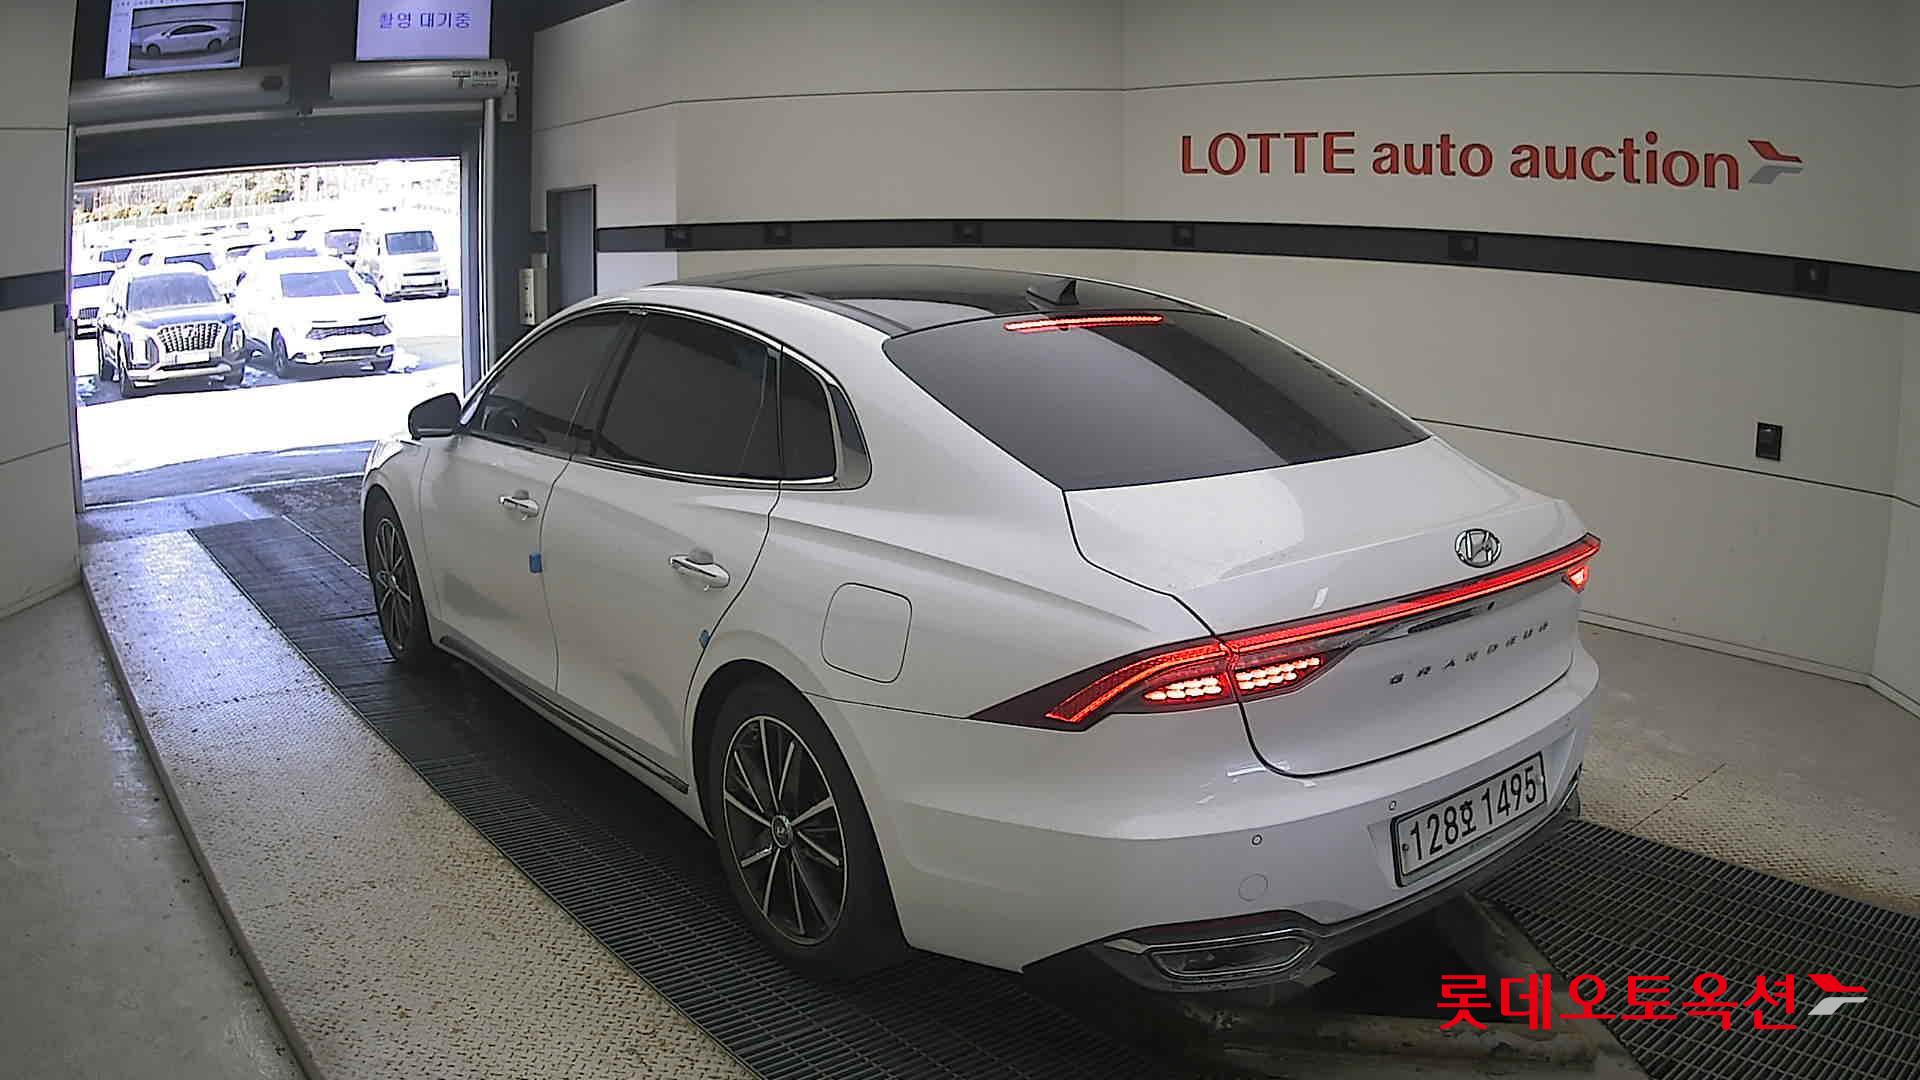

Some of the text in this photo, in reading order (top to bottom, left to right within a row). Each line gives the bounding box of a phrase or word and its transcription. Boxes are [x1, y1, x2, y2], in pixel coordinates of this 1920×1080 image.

[420, 12, 470, 29] 대기중
[1181, 130, 1740, 190] LOTTE auto auction
[1389, 621, 1549, 685] GRANDEUR
[1410, 765, 1537, 861] 128호 1495
